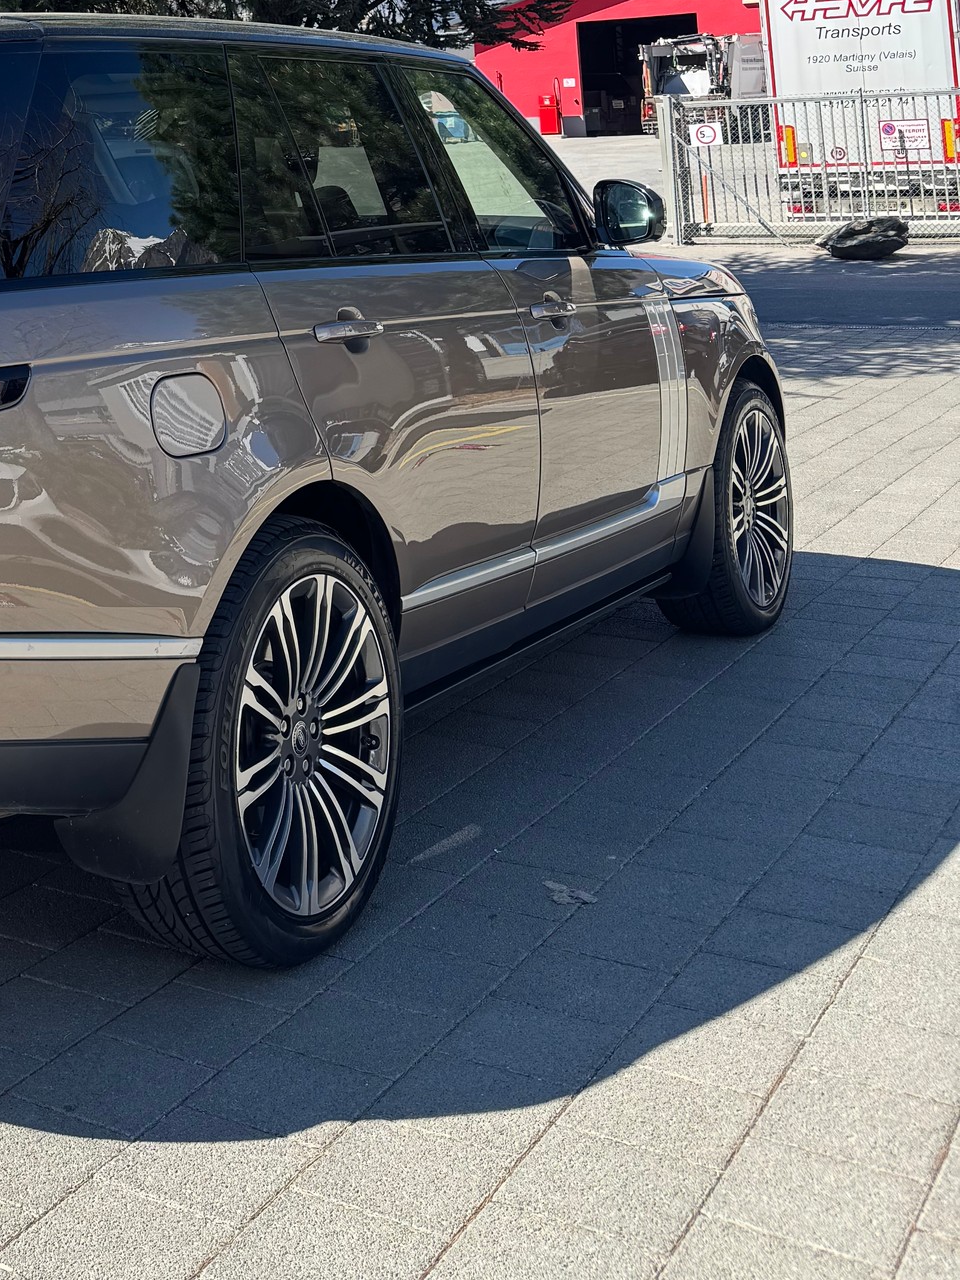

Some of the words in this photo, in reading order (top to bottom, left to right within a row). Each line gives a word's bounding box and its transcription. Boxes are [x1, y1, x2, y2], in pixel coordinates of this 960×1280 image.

[815, 23, 902, 40] Transports
[807, 55, 830, 64] 1920
[833, 52, 876, 63] Martigny
[879, 49, 917, 61] (Valais)
[845, 63, 879, 73] Suisse
[699, 130, 705, 138] 5
